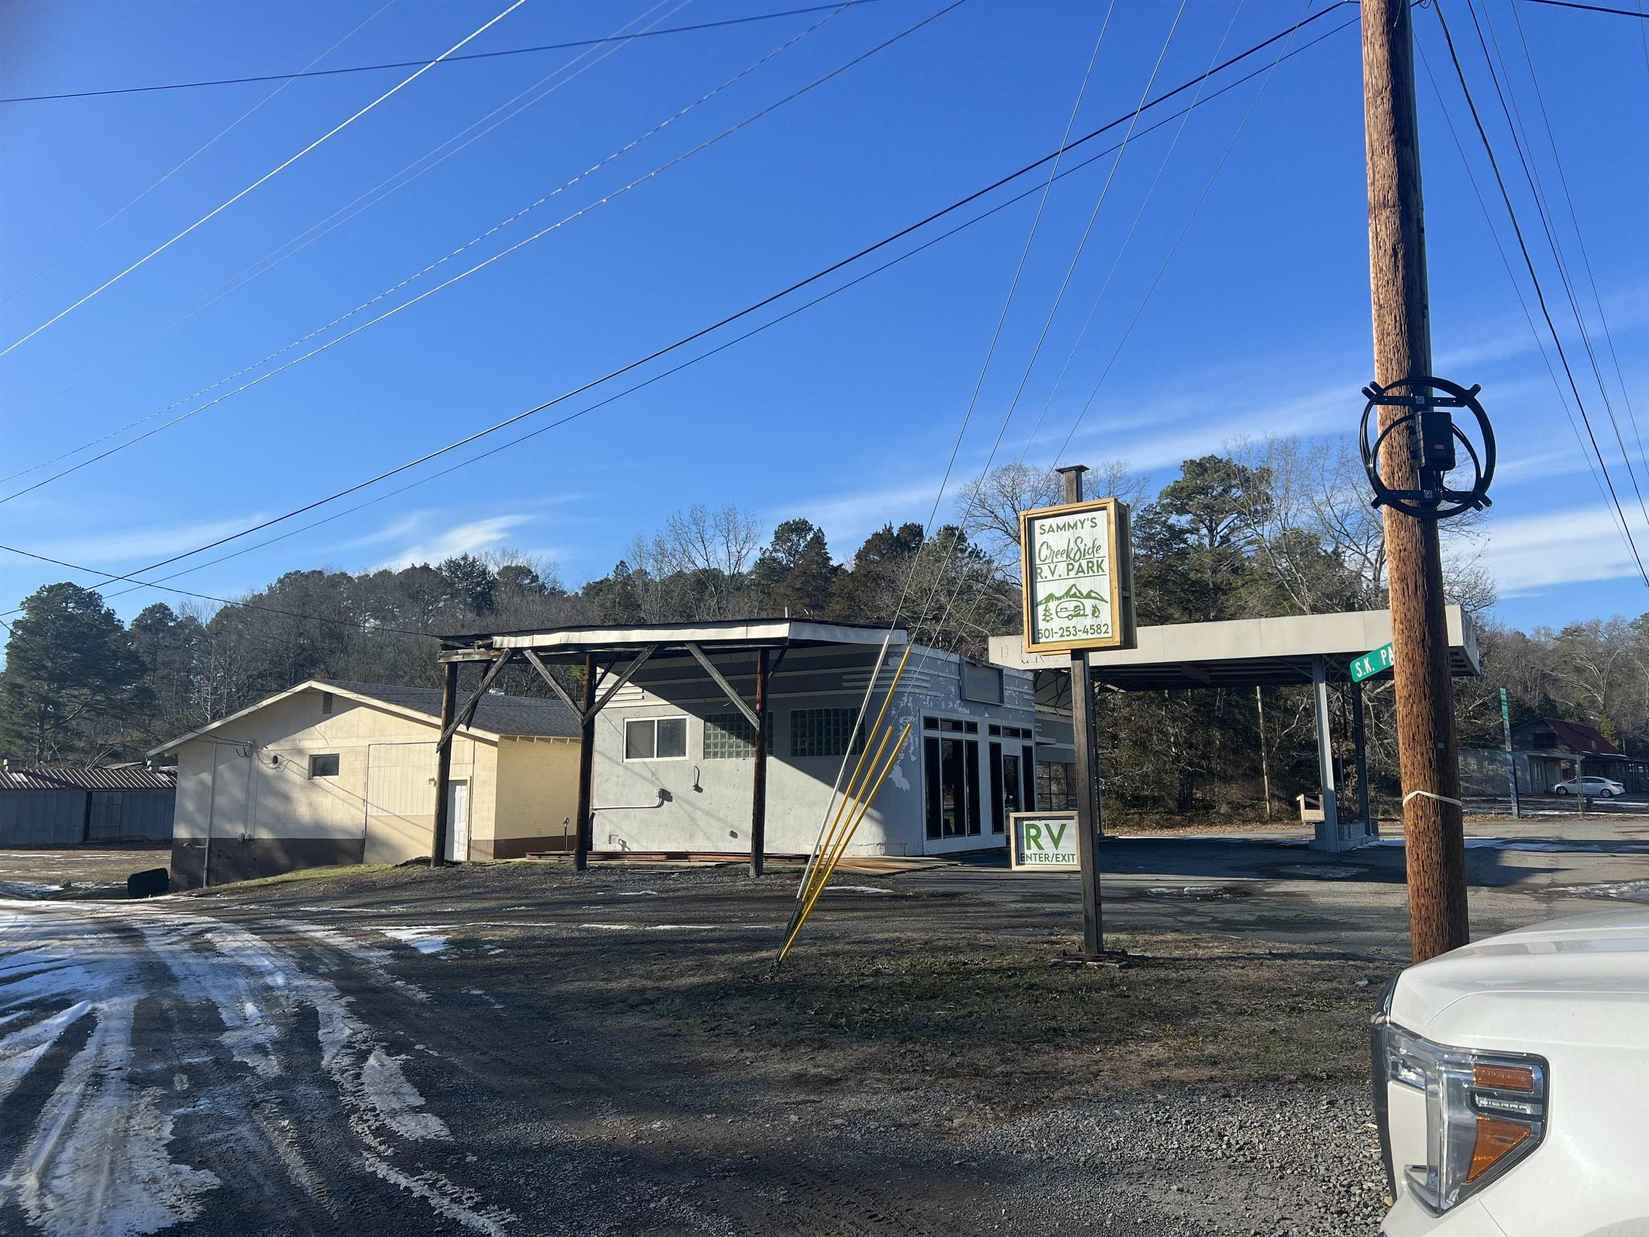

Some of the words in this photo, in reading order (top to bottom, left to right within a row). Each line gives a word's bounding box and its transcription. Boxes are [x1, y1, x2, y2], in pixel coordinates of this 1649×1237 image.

[1039, 517, 1098, 535] SAMMY'S
[1036, 565, 1062, 580] R.V.
[1066, 559, 1106, 577] PARK
[1037, 623, 1110, 640] 501-253-4582
[1355, 657, 1375, 678] S.K.
[1025, 823, 1067, 851] RV
[1020, 853, 1076, 863] ENTER/EXIT
